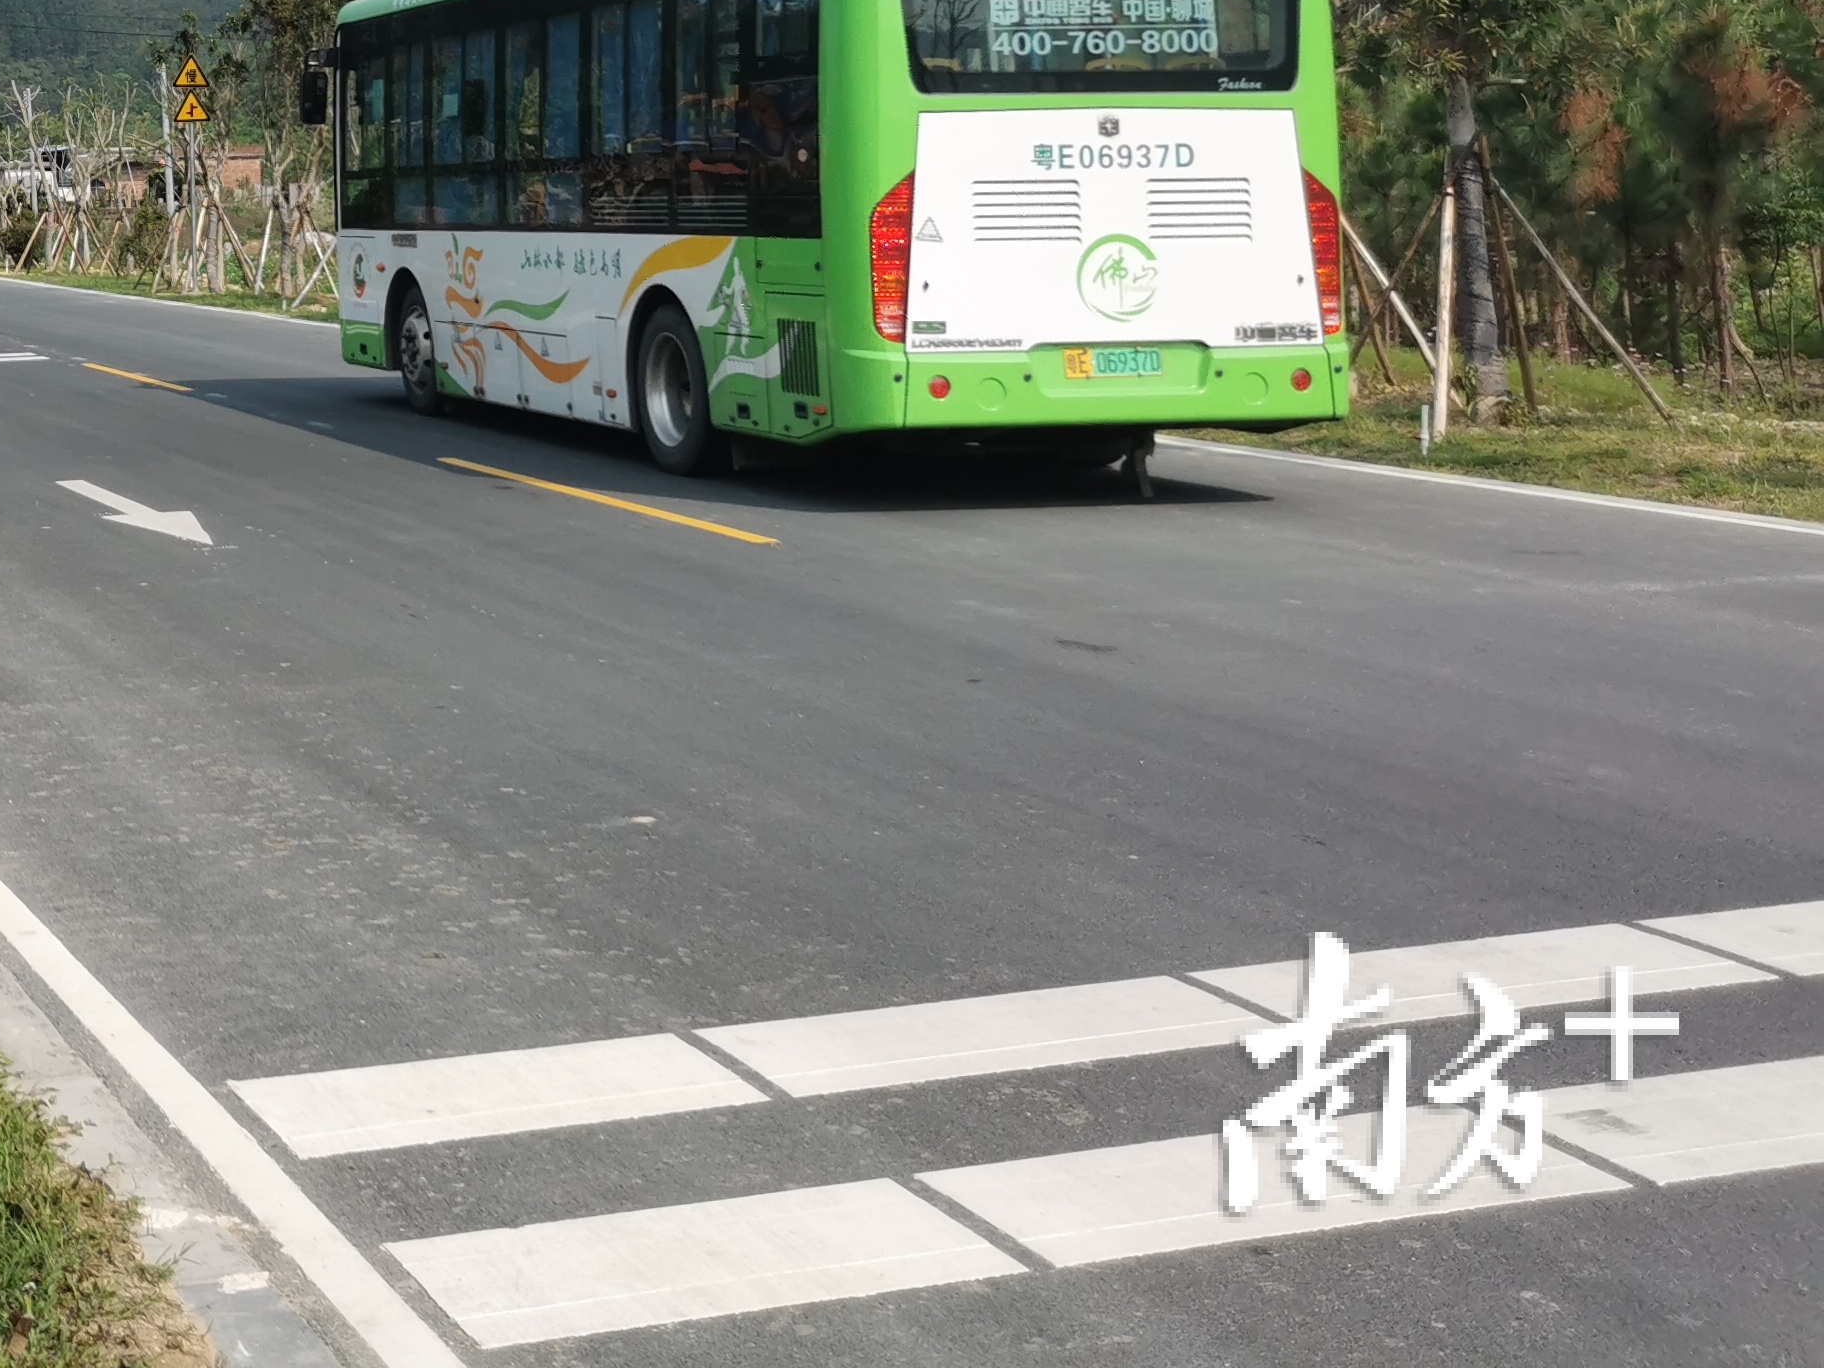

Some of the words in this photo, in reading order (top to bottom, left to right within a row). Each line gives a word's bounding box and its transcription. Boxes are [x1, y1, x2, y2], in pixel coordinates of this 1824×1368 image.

[991, 30, 1218, 56] 400-760-8000
[185, 68, 197, 83] 慢
[1030, 142, 1195, 171] 粤E06937D
